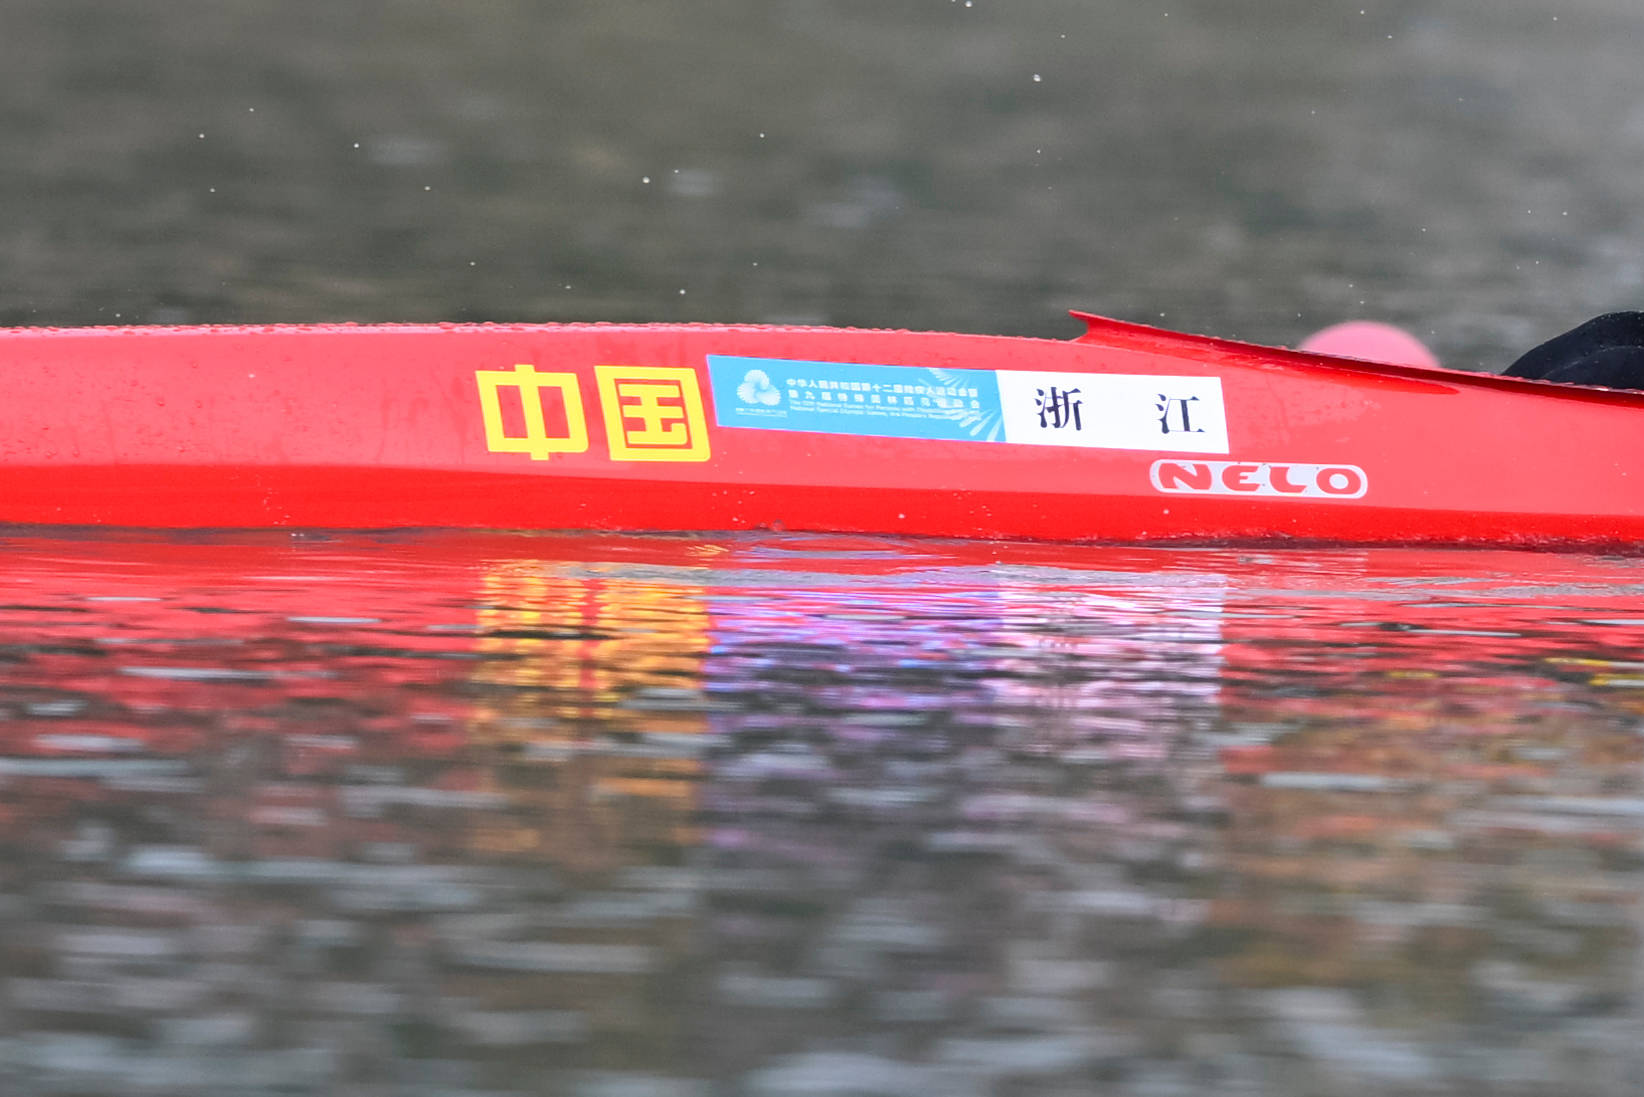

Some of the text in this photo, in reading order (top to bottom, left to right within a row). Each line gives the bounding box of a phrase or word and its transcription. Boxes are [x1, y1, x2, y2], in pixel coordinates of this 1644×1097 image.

[475, 364, 711, 462] 中国
[1033, 386, 1206, 434] 浙江
[1158, 463, 1362, 495] NELO
